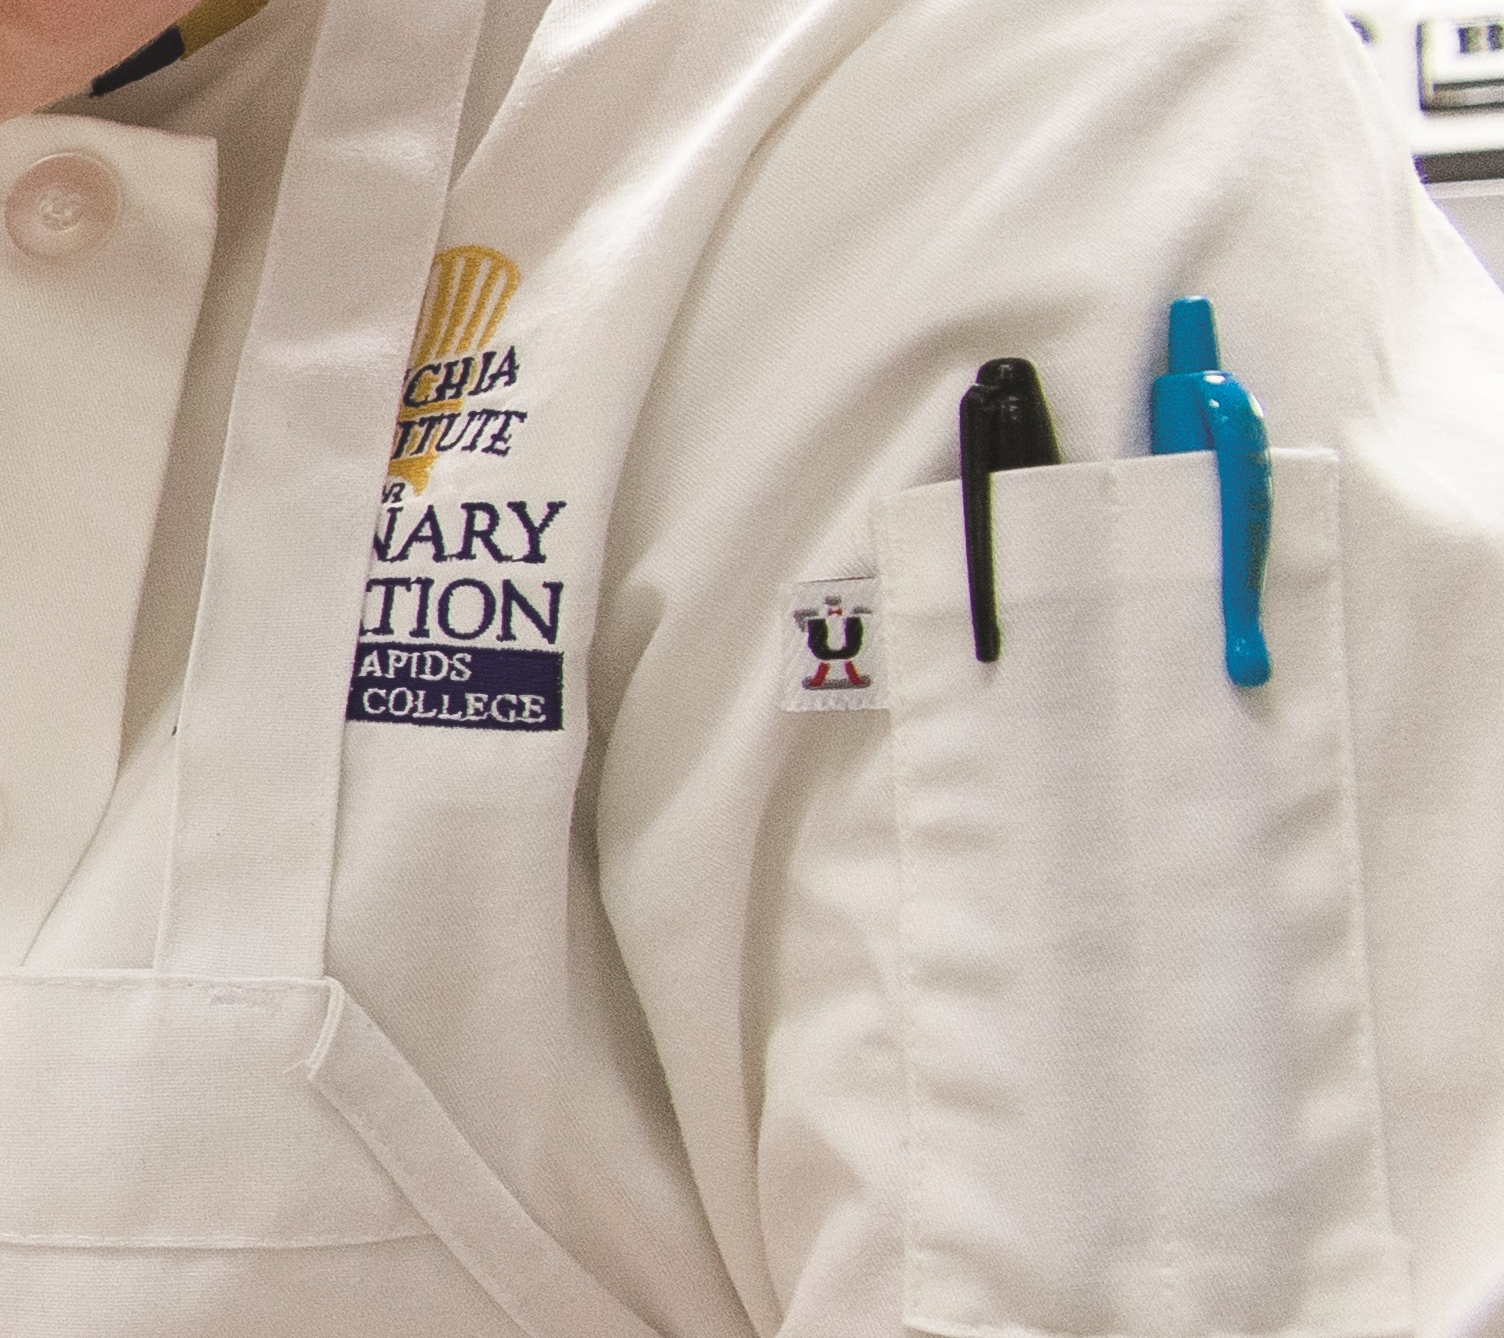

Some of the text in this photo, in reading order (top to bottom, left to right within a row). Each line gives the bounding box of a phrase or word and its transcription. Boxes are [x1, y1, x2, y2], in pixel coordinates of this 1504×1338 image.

[404, 345, 520, 408] CHIA
[360, 577, 564, 644] TION
[358, 650, 472, 681] APIDS
[362, 687, 546, 724] COLLEGE
